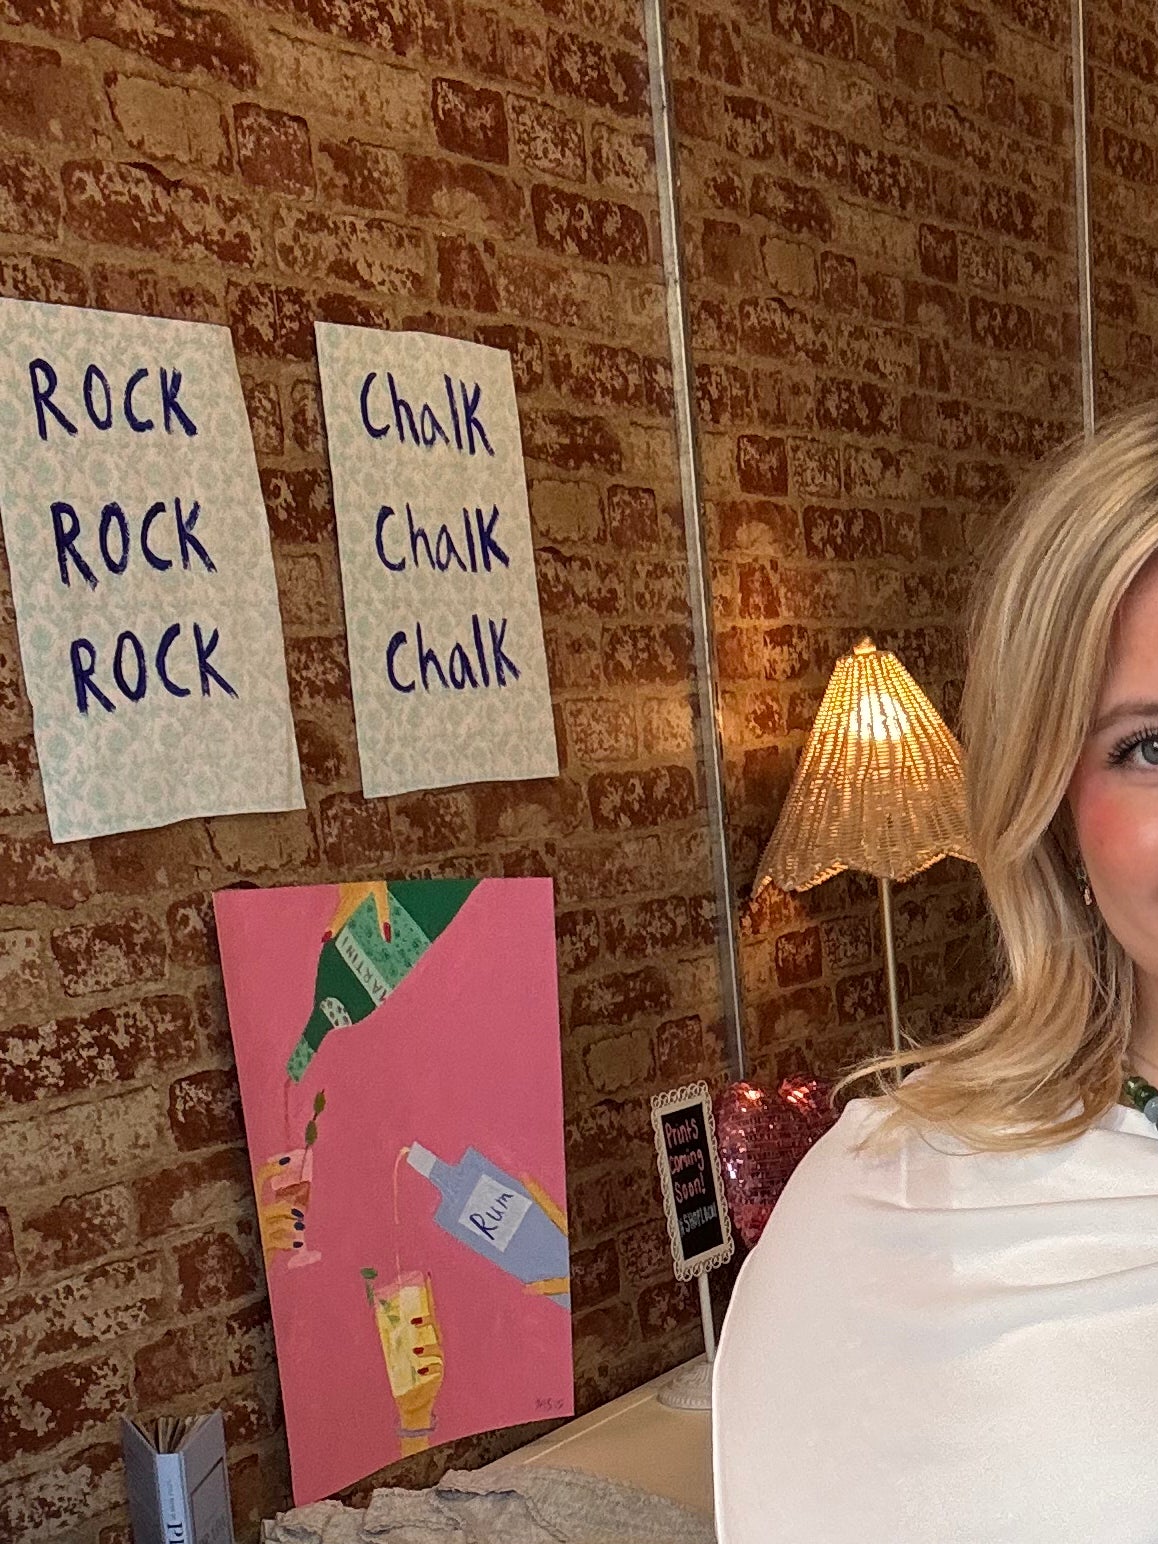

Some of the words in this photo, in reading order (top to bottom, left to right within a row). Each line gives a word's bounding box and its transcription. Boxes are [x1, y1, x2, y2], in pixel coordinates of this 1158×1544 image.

[29, 358, 198, 441] ROCK
[50, 497, 218, 591] ROCK
[70, 622, 240, 716] ROCK
[665, 1118, 698, 1148] Prints
[469, 1192, 515, 1241] Rum
